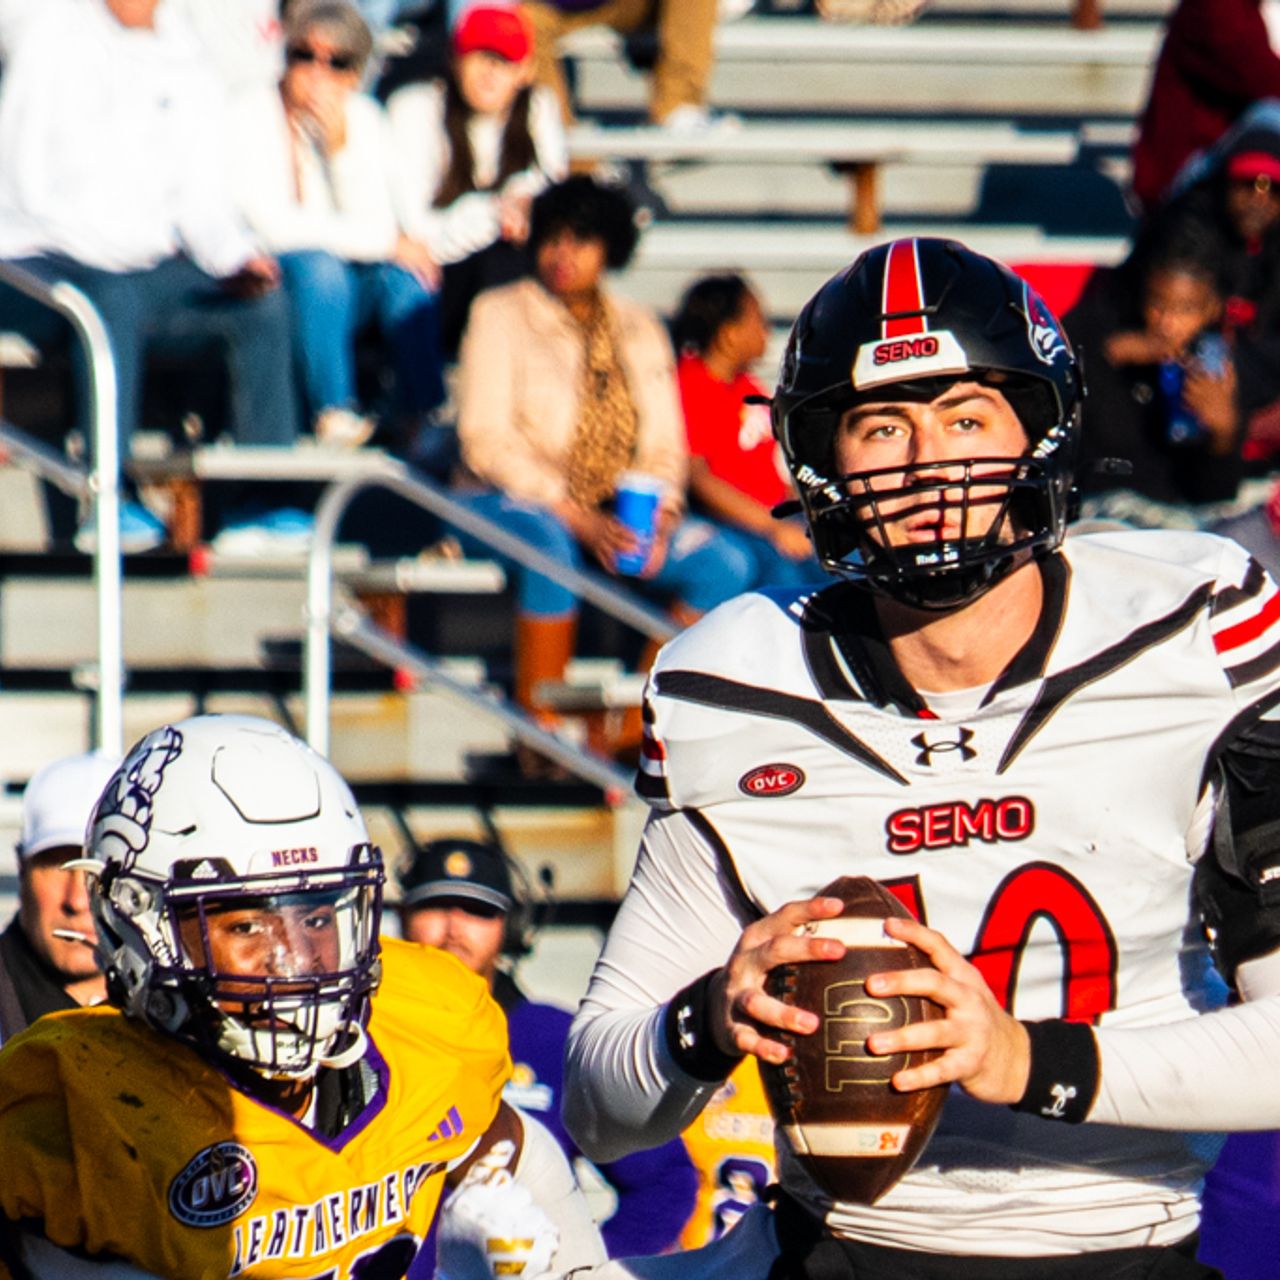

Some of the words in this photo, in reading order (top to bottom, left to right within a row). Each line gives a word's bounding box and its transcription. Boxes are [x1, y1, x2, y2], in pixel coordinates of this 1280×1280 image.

[873, 337, 939, 366] SEMO
[754, 772, 788, 790] OVC
[886, 796, 1035, 855] SEMO
[271, 847, 319, 867] NECKS
[880, 861, 1118, 1026] 0
[191, 1161, 245, 1208] OVC
